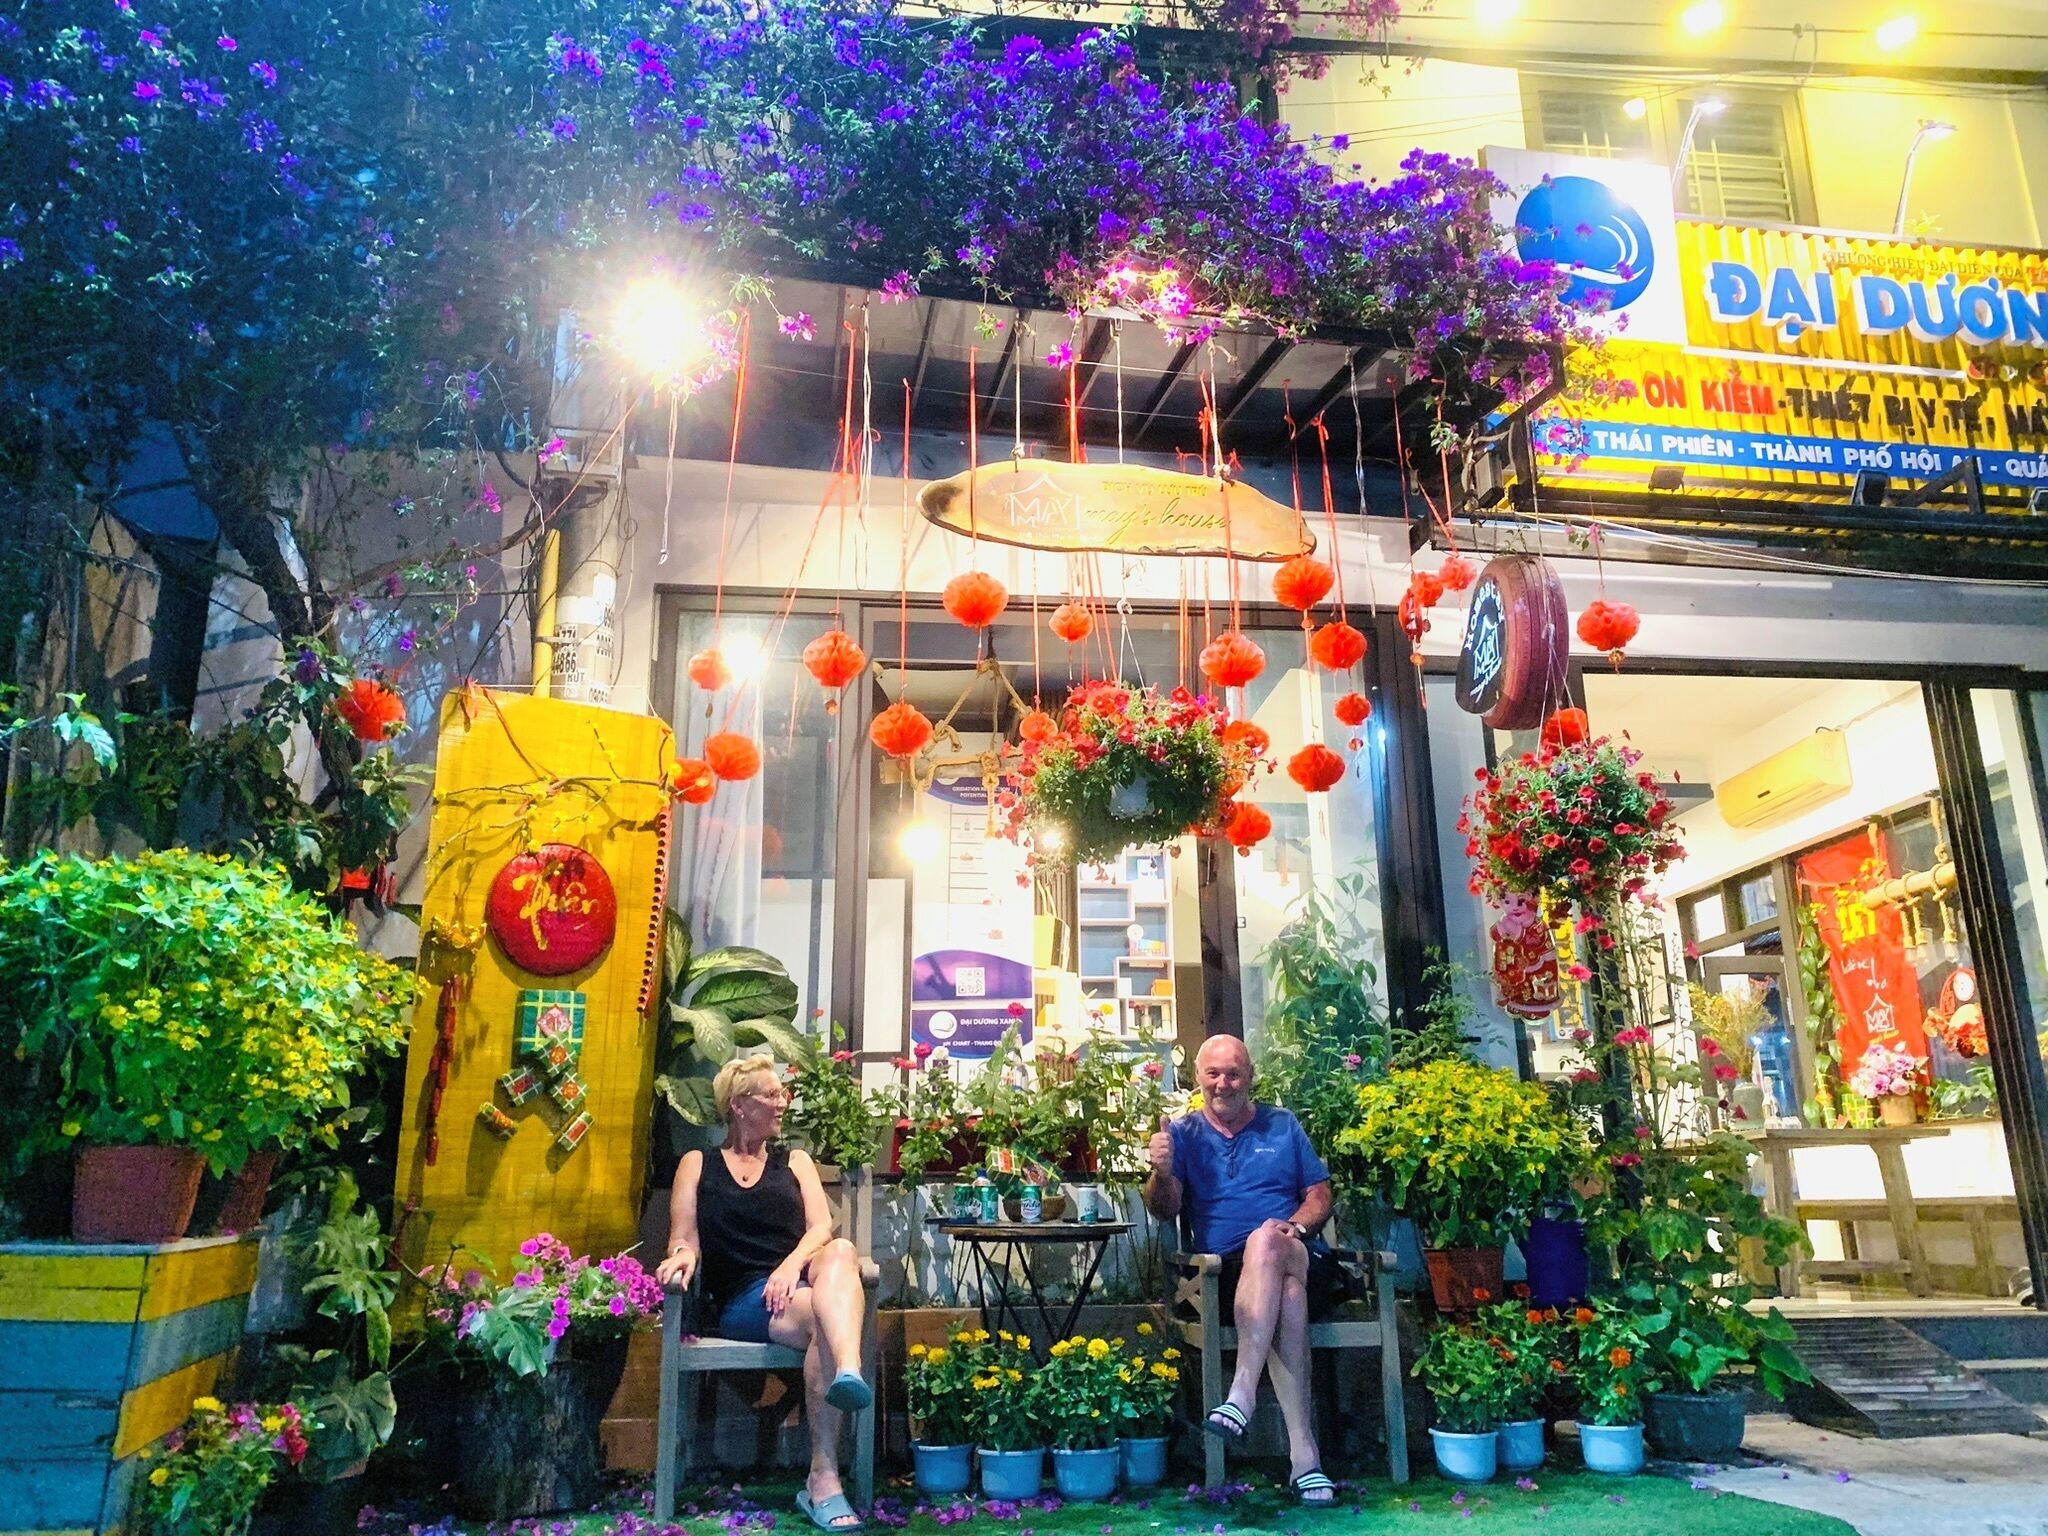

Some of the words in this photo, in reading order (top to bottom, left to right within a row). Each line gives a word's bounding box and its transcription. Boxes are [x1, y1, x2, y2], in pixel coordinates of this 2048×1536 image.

[1708, 261, 1838, 338] ĐẠI
[1592, 428, 1653, 452] THÁI
[1661, 430, 1735, 458] PHIÊN
[1750, 438, 1834, 465] THÀNH
[1844, 441, 1893, 469] PHỐ
[1901, 448, 1943, 475] HỘI
